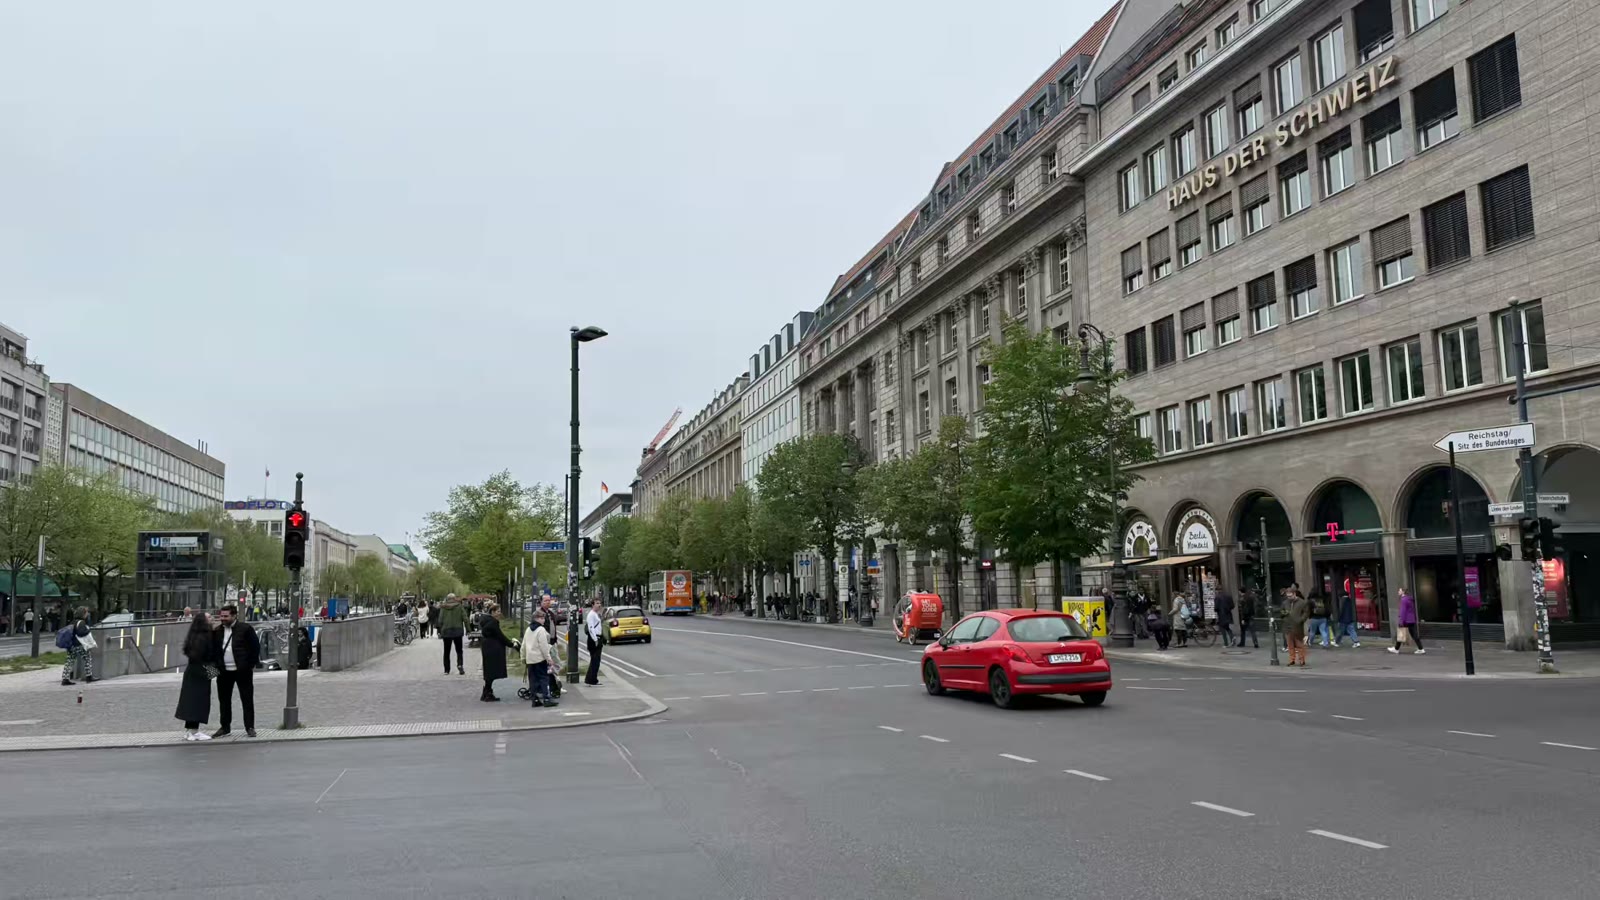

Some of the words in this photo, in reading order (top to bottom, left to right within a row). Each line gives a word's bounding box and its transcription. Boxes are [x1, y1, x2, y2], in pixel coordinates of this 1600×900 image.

[1166, 164, 1219, 211] HAUS
[1224, 135, 1266, 178] DER
[1275, 55, 1397, 147] SCHWEIZ
[1468, 428, 1512, 441] Reichstag/
[1458, 442, 1470, 451] Sitz
[1472, 441, 1483, 449] des
[1485, 437, 1525, 448] Bundestages
[150, 537, 159, 547] U
[1188, 531, 1206, 540] Berlin
